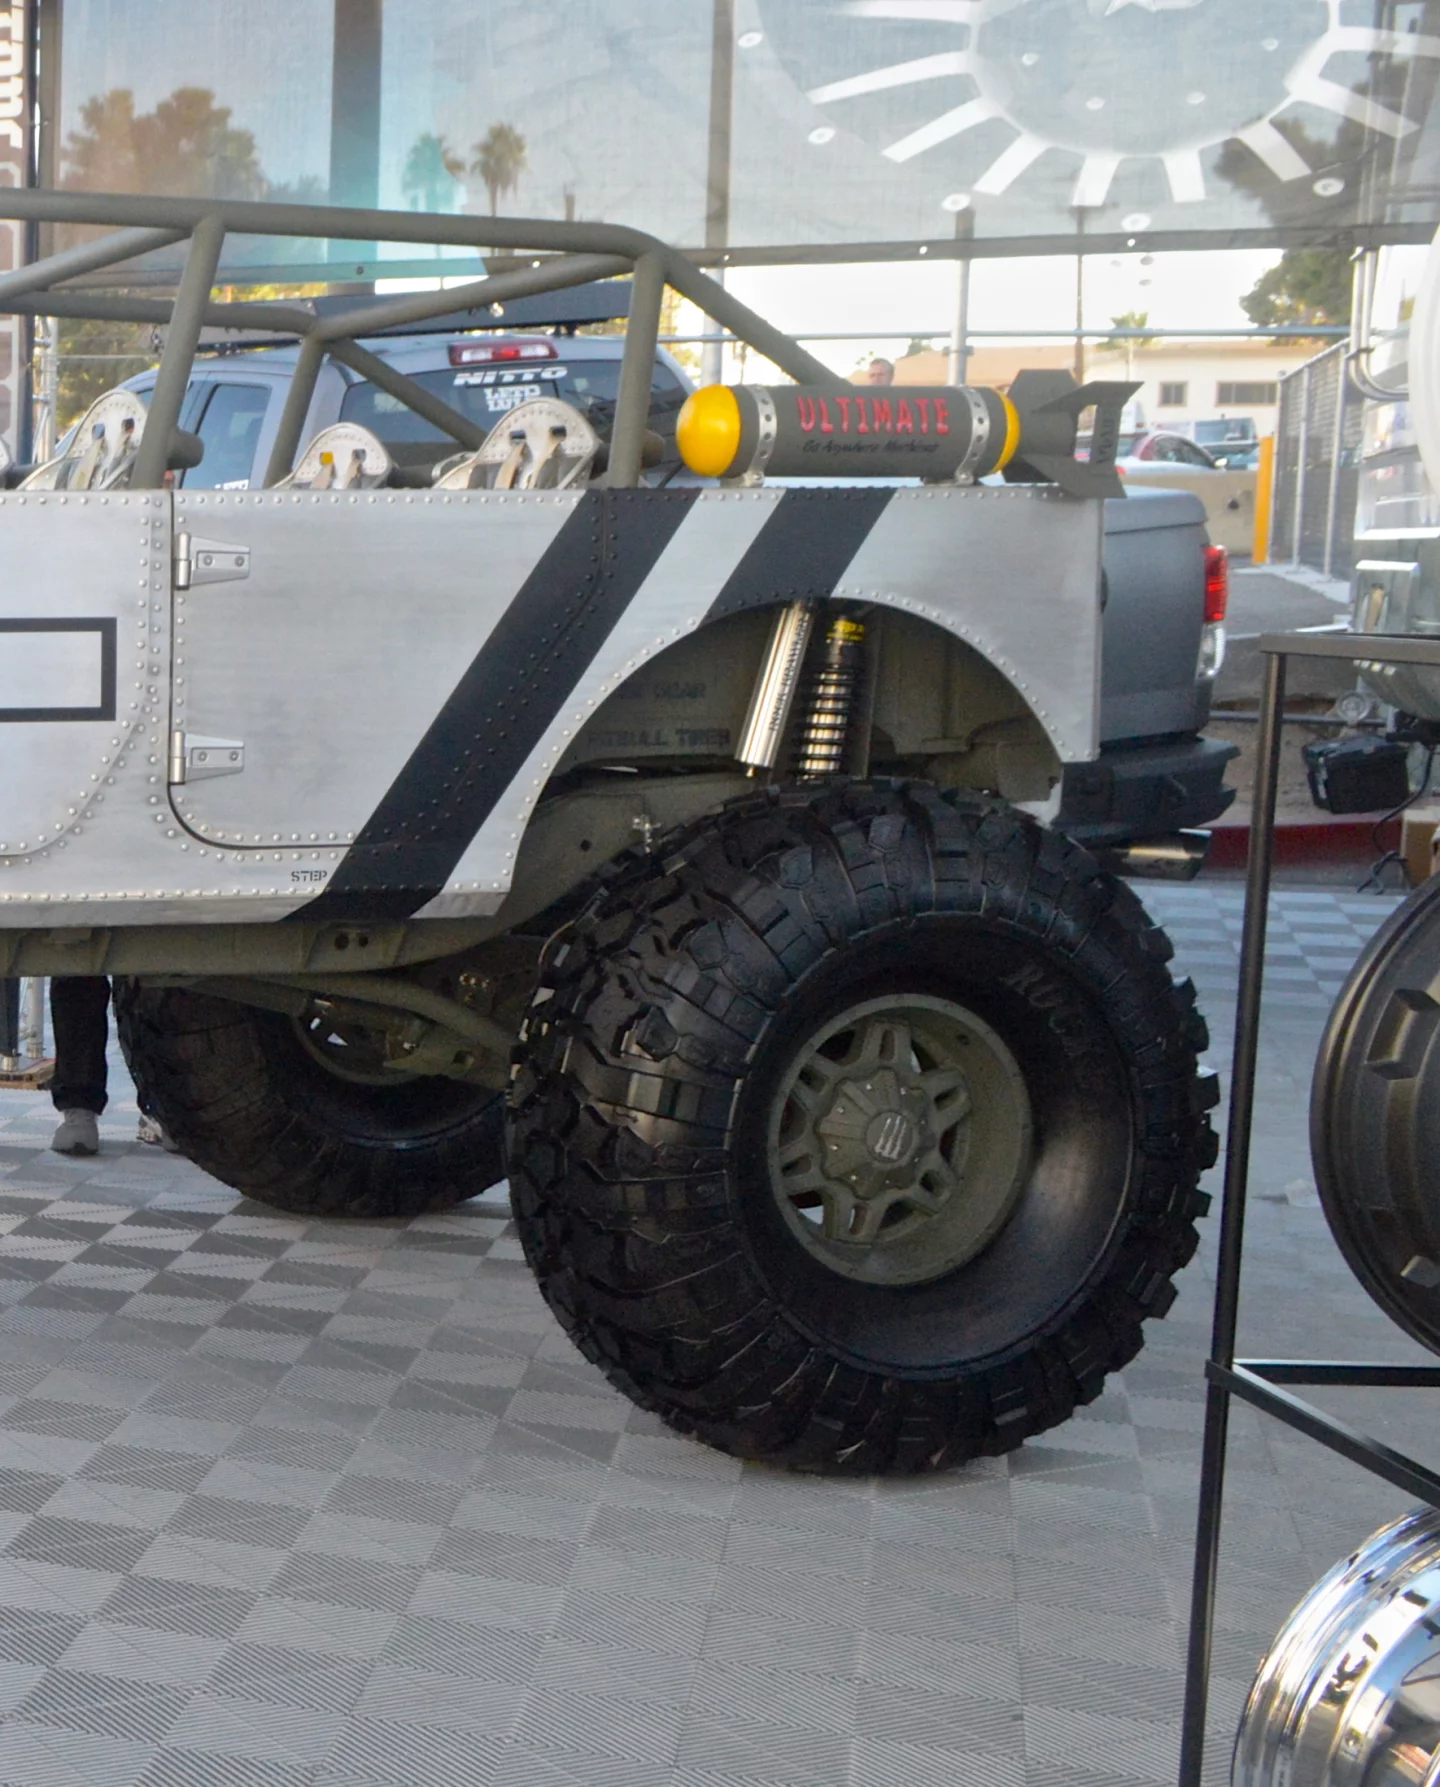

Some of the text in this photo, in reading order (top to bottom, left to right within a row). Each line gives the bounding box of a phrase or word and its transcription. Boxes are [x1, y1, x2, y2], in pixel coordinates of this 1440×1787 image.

[453, 366, 568, 386] NITTO
[797, 395, 950, 435] ULTIMATE
[290, 870, 328, 882] STEP
